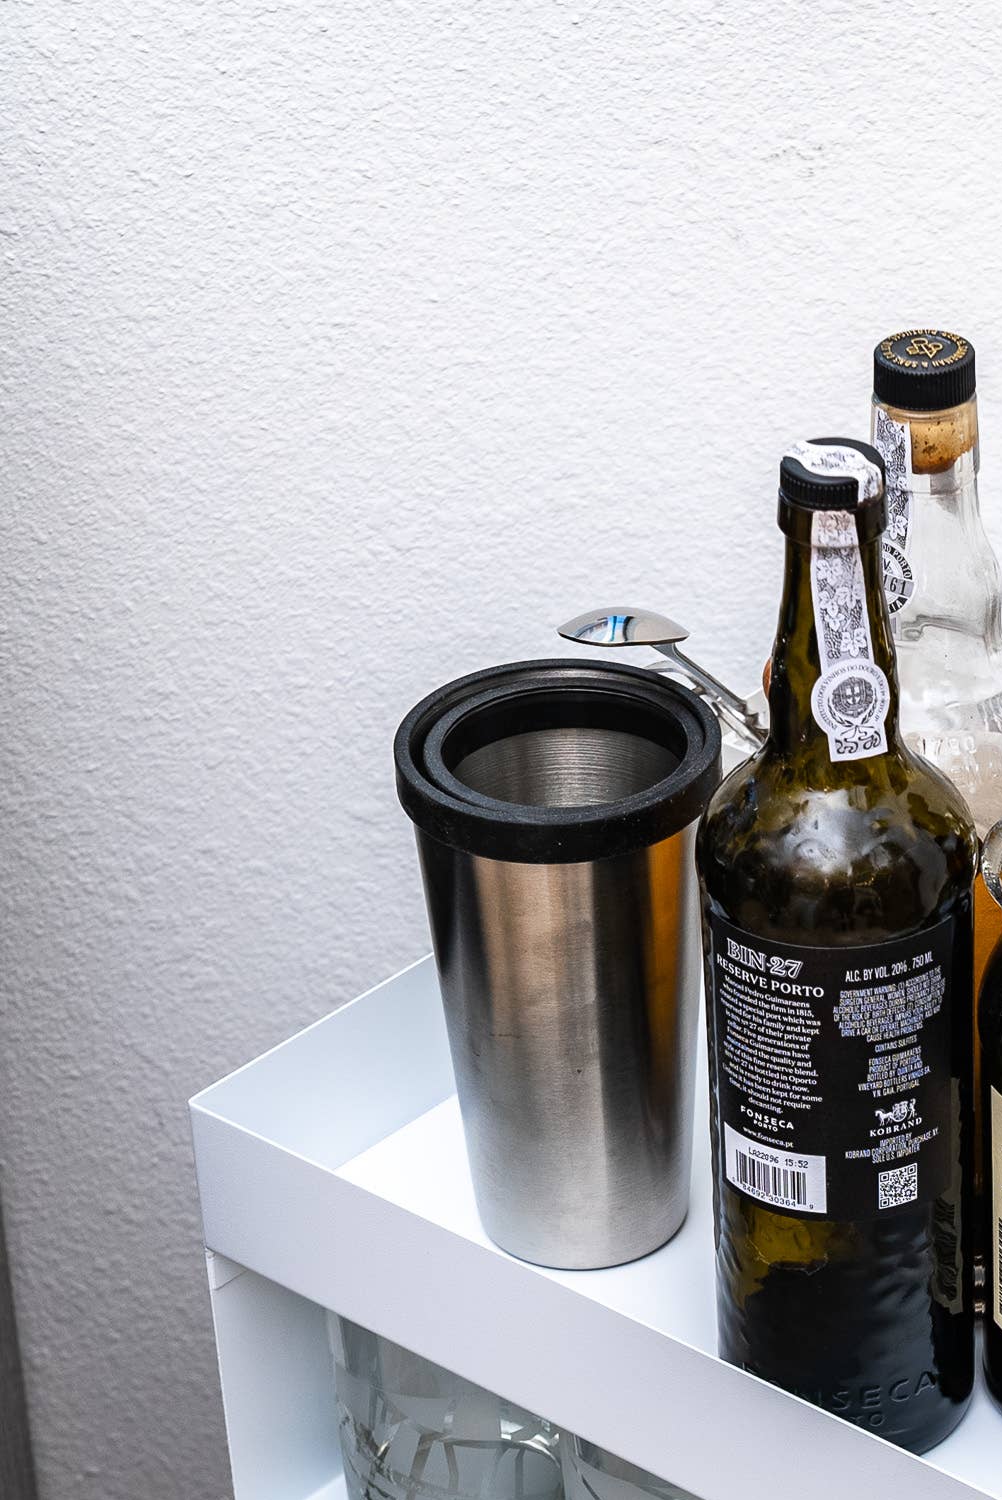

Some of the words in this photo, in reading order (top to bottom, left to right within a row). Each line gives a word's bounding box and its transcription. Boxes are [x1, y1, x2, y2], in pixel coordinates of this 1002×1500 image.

[893, 551, 912, 579] PORTO
[716, 953, 768, 989] RESERVE
[771, 980, 824, 998] PORTO
[845, 969, 862, 982] ALC.
[863, 968, 873, 981] BY
[874, 965, 890, 979] VOL.
[912, 954, 925, 969] 750
[925, 951, 933, 964] ML
[740, 1104, 795, 1130] FONSECA
[753, 1120, 778, 1132] PORTO
[869, 1117, 922, 1137] KOBRAND
[742, 1126, 795, 1148] www.fonseca.pt
[784, 1158, 809, 1169] 15:52
[768, 1195, 796, 1207] 30364
